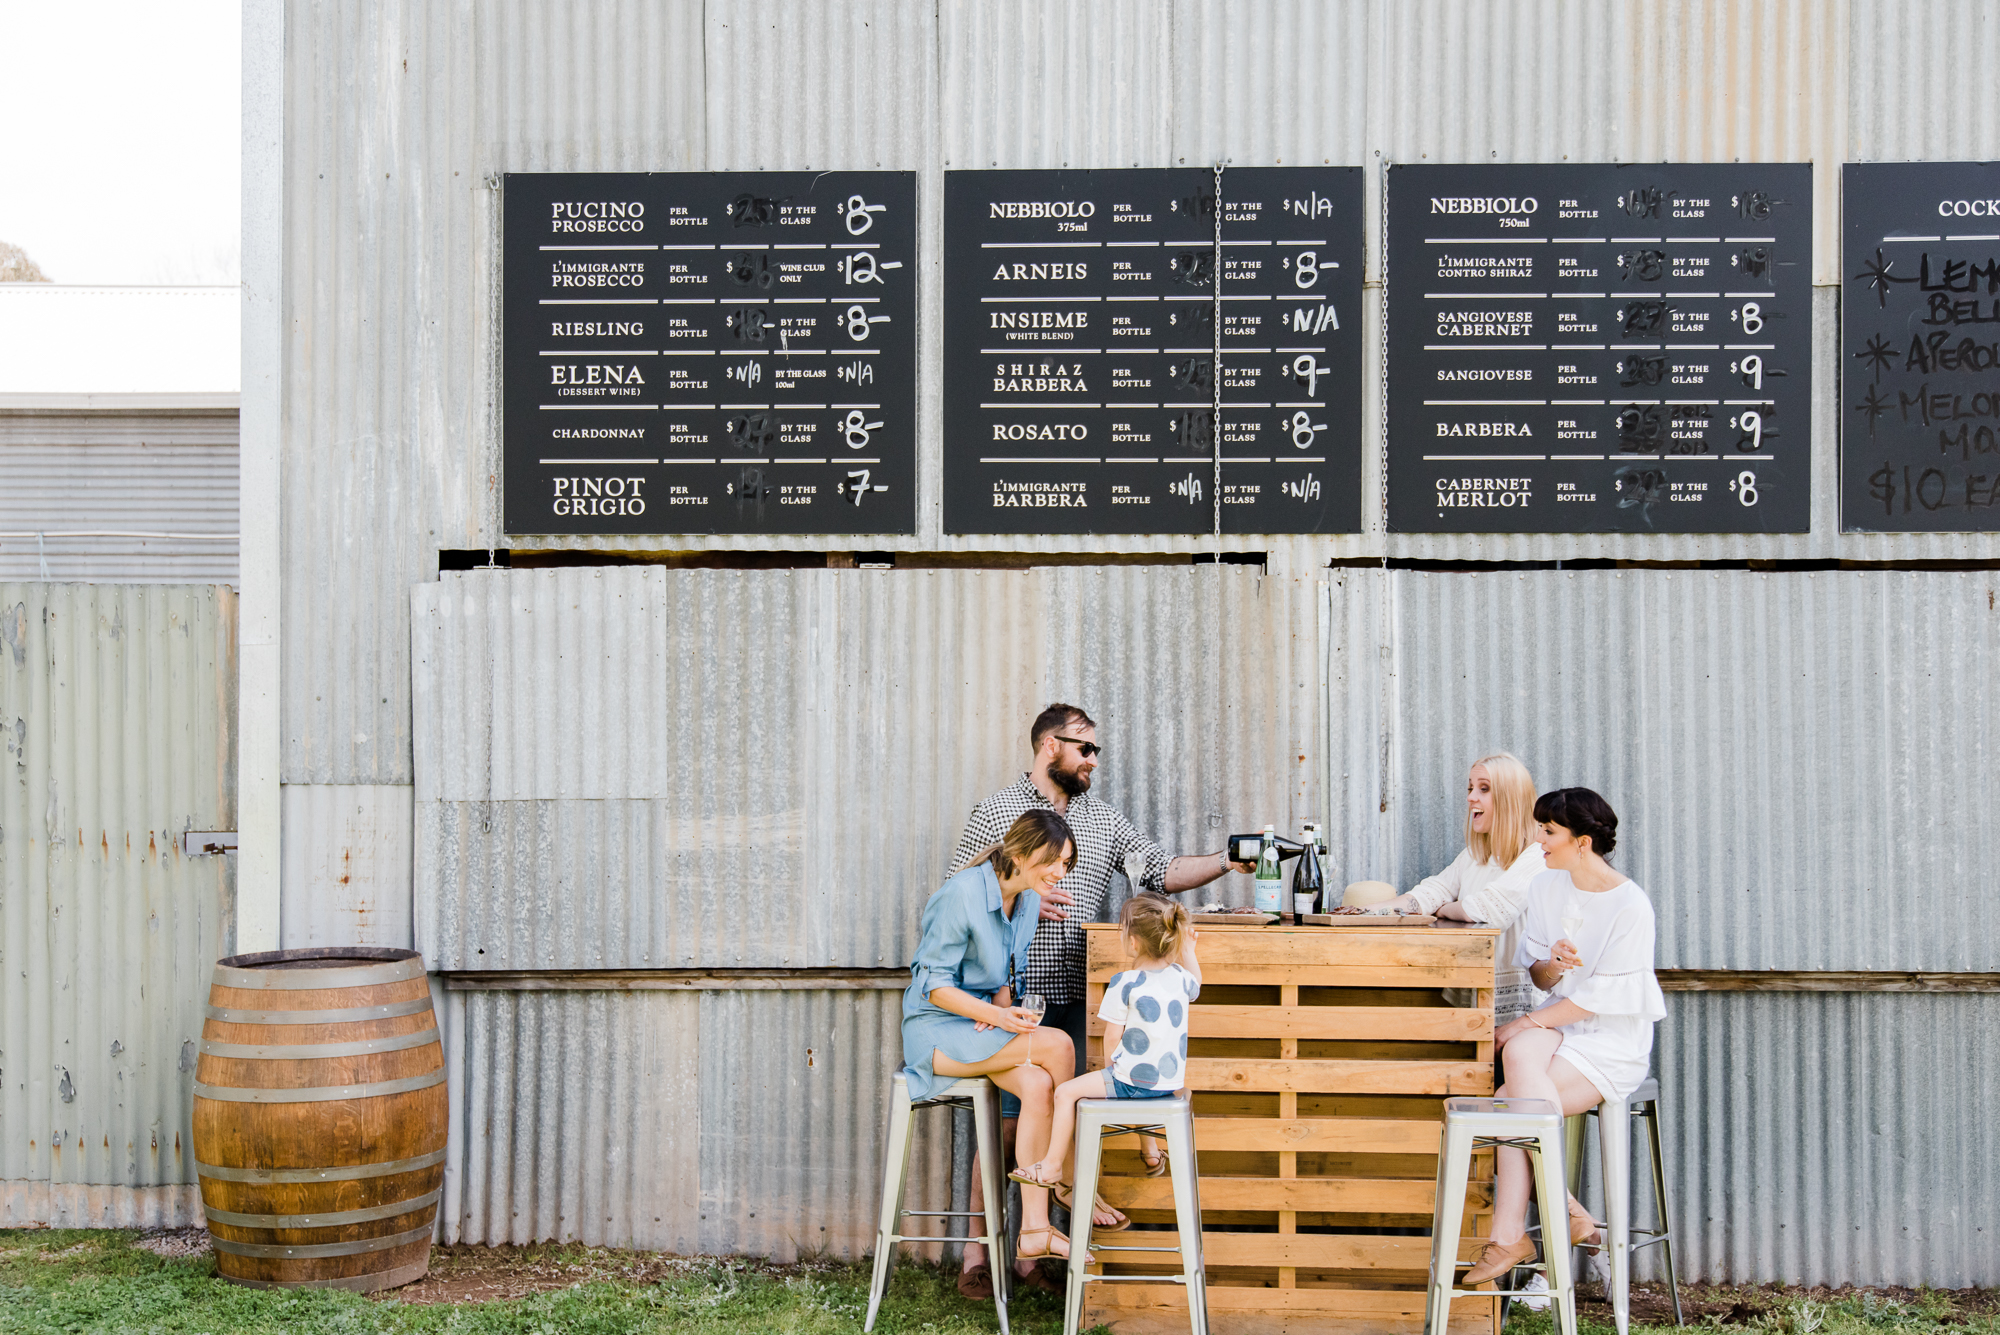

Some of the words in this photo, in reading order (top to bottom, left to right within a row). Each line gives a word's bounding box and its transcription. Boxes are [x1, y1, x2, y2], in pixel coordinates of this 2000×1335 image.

[1113, 203, 1132, 212] PER
[1225, 202, 1239, 211] BY
[1240, 202, 1263, 211] THE
[1431, 197, 1538, 213] NEBBIOLO
[1558, 199, 1579, 208] PER
[1672, 199, 1686, 208] BY
[1688, 198, 1711, 207] THE
[552, 202, 644, 218] PUCINO
[669, 207, 689, 215] PER
[780, 206, 793, 215] BY
[795, 206, 817, 215] THE
[990, 201, 1095, 218] NEBBIOLO
[1672, 209, 1705, 218] GLASS
[1113, 214, 1153, 223] BOTTLE
[1224, 213, 1257, 222] GLASS
[1558, 210, 1599, 219] BOTTLE
[669, 217, 709, 226] BOTTLE
[779, 217, 812, 225] GLASS
[1498, 217, 1530, 228] 750ml
[551, 219, 644, 233] PROSECCO
[1057, 221, 1088, 232] 375ml
[1225, 261, 1238, 269] BY
[1240, 260, 1262, 269] THE
[1438, 254, 1533, 268] L'IMMIGRANTE
[1558, 258, 1578, 267] PER
[1672, 257, 1686, 266] BY
[1688, 257, 1710, 266] THE
[552, 259, 645, 273] L'IMMIGRANTE
[669, 264, 689, 273] PER
[779, 264, 803, 272] WINE
[802, 263, 826, 272] CLUB
[1112, 262, 1132, 270] PER
[993, 263, 1087, 280] ARNEIS
[1224, 271, 1257, 280] GLASS
[1437, 268, 1487, 278] CONTRO
[1489, 268, 1533, 278] SHIRAZ
[1558, 268, 1599, 277] BOTTLE
[1671, 268, 1705, 277] GLASS
[551, 274, 644, 287] PROSECCO
[669, 275, 708, 284] BOTTLE
[779, 274, 803, 283] ONLY
[1112, 272, 1152, 281] BOTTLE
[991, 312, 1088, 328] INSIEME
[1112, 317, 1132, 325] PER
[1224, 316, 1238, 325] BY
[1240, 316, 1262, 325] THE
[1437, 311, 1533, 323] SANGIOVESE
[1558, 313, 1578, 322] PER
[1672, 312, 1686, 321] BY
[1687, 312, 1710, 321] THE
[669, 318, 689, 327] PER
[780, 318, 793, 327] BY
[795, 318, 817, 327] THE
[551, 322, 644, 336] RIESLING
[1112, 327, 1152, 336] BOTTLE
[1224, 327, 1256, 336] GLASS
[1436, 323, 1533, 337] CABERNET
[1558, 323, 1598, 333] BOTTLE
[1671, 323, 1705, 332] GLASS
[669, 329, 708, 338] BOTTLE
[779, 328, 812, 339] GLASS
[1005, 332, 1039, 341] (WHITE
[1041, 331, 1074, 341] BLEND)
[775, 369, 786, 378] BY
[785, 368, 803, 378] THE
[802, 369, 827, 378] GLASS
[996, 363, 1082, 376] SHIRAZ
[1112, 368, 1132, 377] PER
[1224, 368, 1238, 377] BY
[1239, 368, 1262, 377] THE
[1557, 365, 1578, 374] PER
[1671, 364, 1685, 373] BY
[1687, 364, 1710, 373] THE
[551, 366, 645, 384] ELENA
[669, 370, 689, 379] PER
[1437, 369, 1533, 381] SANGIOVESE
[1112, 379, 1152, 388] BOTTLE
[1224, 379, 1256, 387] GLASS
[1557, 375, 1598, 384] BOTTLE
[1671, 375, 1704, 384] GLASS
[669, 380, 709, 389] BOTTLE
[775, 380, 796, 389] 100ml
[993, 378, 1088, 392] BARBERA
[557, 387, 607, 397] (DESSERT
[609, 387, 641, 397] WINE)
[780, 424, 794, 432] BY
[795, 424, 817, 432] THE
[1112, 423, 1132, 432] PER
[1224, 423, 1238, 431] BY
[1239, 423, 1261, 431] THE
[1557, 420, 1577, 429] PER
[1671, 419, 1685, 428] BY
[1686, 419, 1709, 428] THE
[669, 424, 689, 433] PER
[993, 425, 1087, 440] ROSATO
[1436, 422, 1533, 437] BARBERA
[552, 428, 646, 439] CHARDONNAY
[1112, 434, 1152, 442] BOTTLE
[1223, 433, 1256, 442] GLASS
[1557, 430, 1597, 439] BOTTLE
[1670, 430, 1704, 439] GLASS
[669, 435, 709, 443] BOTTLE
[780, 434, 812, 443] GLASS
[553, 478, 645, 496] PINOT
[993, 478, 1087, 492] L'IMMIGRANTE
[1435, 478, 1532, 491] CABERNET
[1556, 482, 1577, 491] PER
[1670, 482, 1684, 491] BY
[1686, 482, 1708, 491] THE
[669, 486, 689, 494] PER
[780, 485, 794, 494] BY
[795, 485, 817, 494] THE
[1111, 485, 1131, 494] PER
[1223, 485, 1237, 494] BY
[1239, 485, 1261, 494] THE
[670, 496, 709, 505] BOTTLE
[780, 496, 812, 505] GLASS
[992, 493, 1088, 508] BARBERA
[1111, 496, 1151, 504] BOTTLE
[1223, 496, 1256, 504] GLASS
[1437, 492, 1531, 507] MERLOT
[1556, 493, 1597, 502] BOTTLE
[1669, 493, 1703, 502] GLASS
[554, 498, 645, 515] GRIGIO
